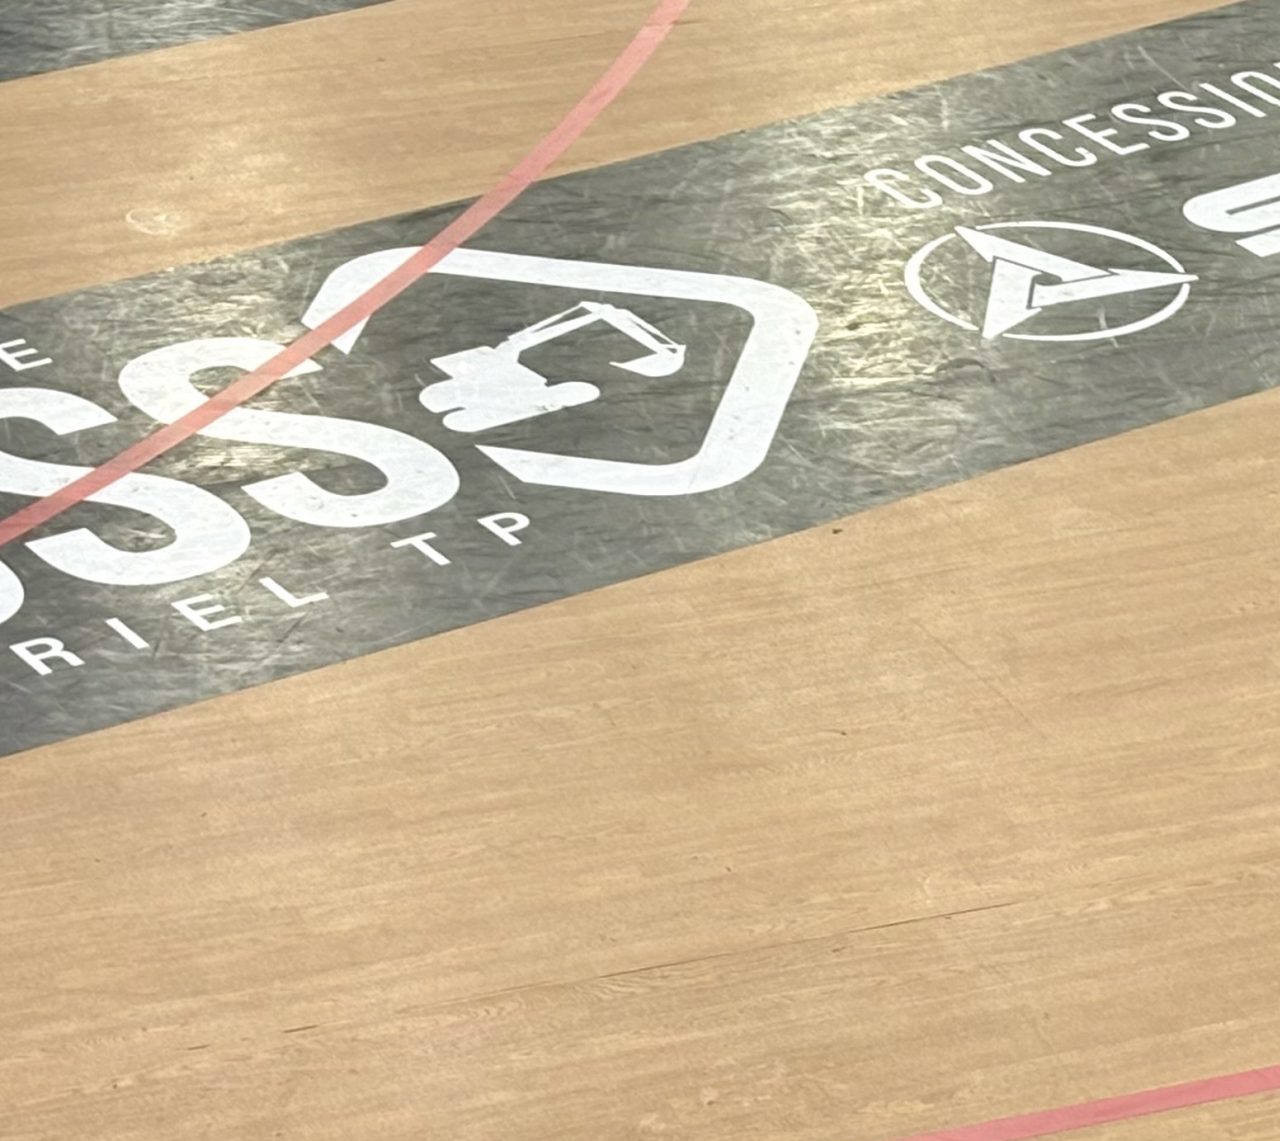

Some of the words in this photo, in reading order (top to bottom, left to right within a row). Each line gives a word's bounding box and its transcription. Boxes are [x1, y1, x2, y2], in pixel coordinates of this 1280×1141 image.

[0, 336, 461, 626] SS
[9, 576, 330, 676] RIEL
[389, 511, 532, 567] TP
